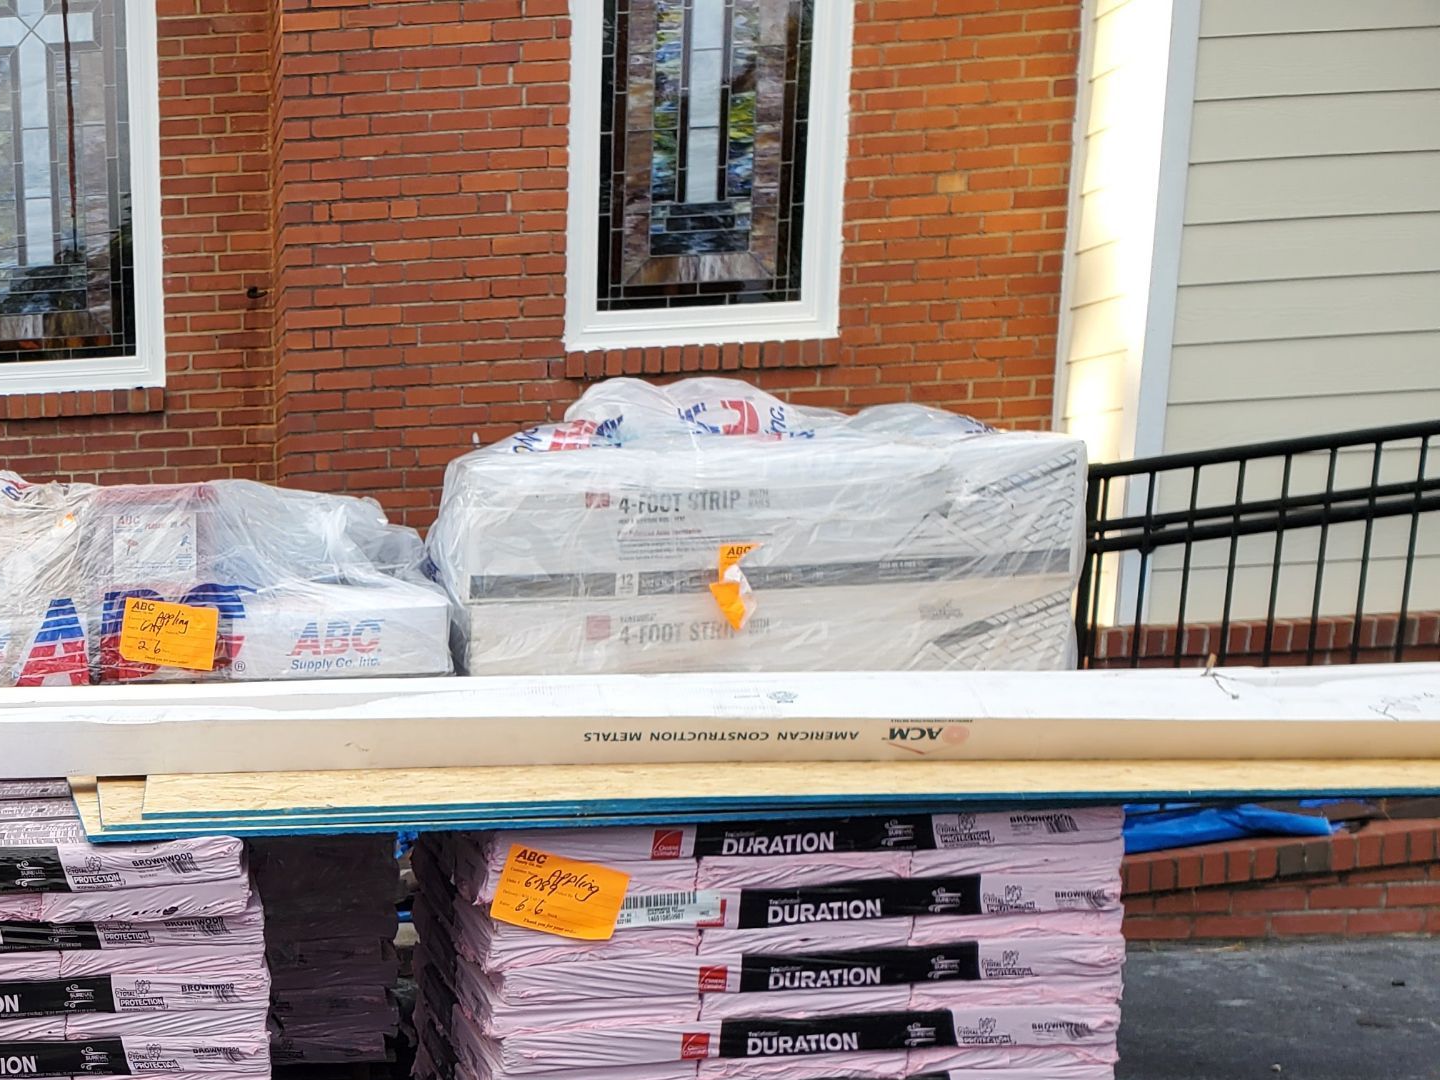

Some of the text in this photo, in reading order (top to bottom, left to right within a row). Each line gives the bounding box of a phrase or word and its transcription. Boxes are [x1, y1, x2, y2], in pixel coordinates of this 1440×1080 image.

[688, 489, 741, 512] STRIP
[132, 601, 155, 611] ABC
[289, 618, 386, 657] ABC
[618, 622, 684, 645] 4-FOOT
[291, 658, 333, 672] Supply
[583, 731, 860, 743] AMERICAN CONSTRUCTION METALS
[886, 726, 943, 742] ACM
[722, 830, 835, 855] DURATION
[941, 831, 991, 842] PROTECTION
[132, 852, 194, 867] BROWNWOOD
[516, 849, 548, 864] ABC
[73, 873, 121, 884] PROTECTION
[548, 870, 599, 902] Appling
[534, 899, 545, 915] 6
[767, 898, 882, 924] DURATION
[163, 916, 225, 927] BROWNWOOD
[105, 930, 150, 941] PROTECTION
[768, 967, 881, 990] DURATION
[120, 996, 165, 1007] PROTECTION
[747, 1031, 859, 1055] DURATION
[134, 1060, 180, 1070] PROTECTION
